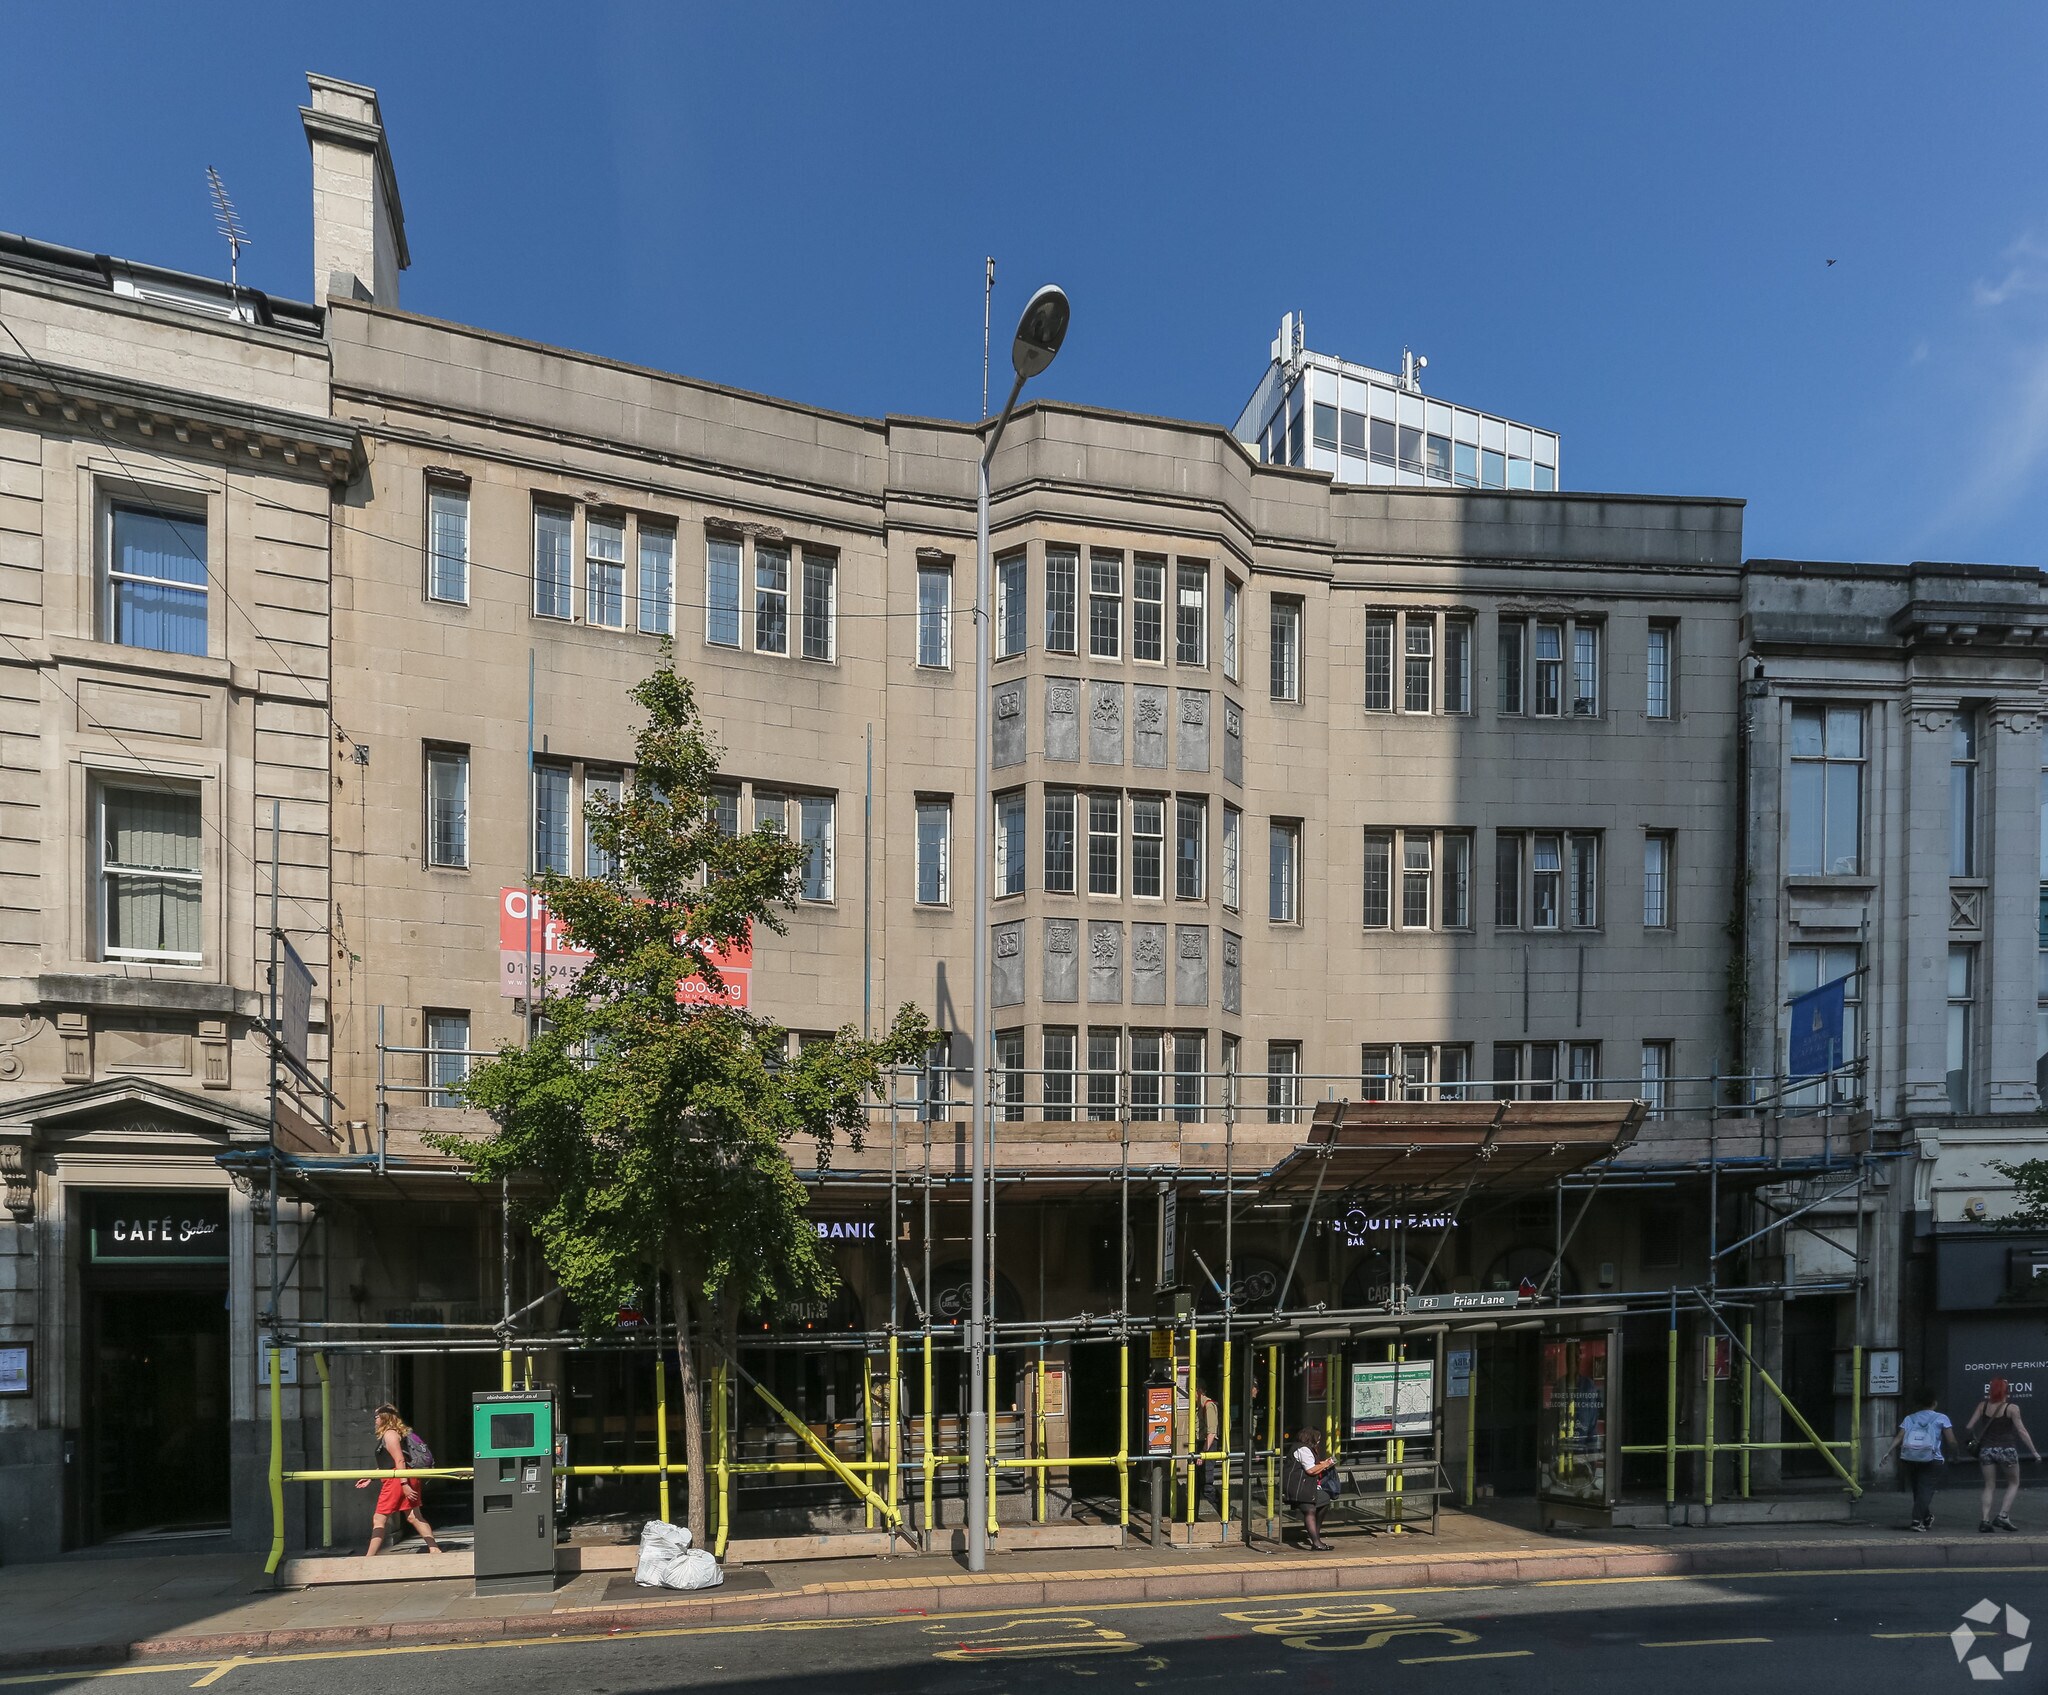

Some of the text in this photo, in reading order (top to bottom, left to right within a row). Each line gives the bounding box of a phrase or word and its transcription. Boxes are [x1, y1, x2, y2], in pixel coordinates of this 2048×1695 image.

[507, 962, 541, 976] 015
[114, 1216, 218, 1242] CAFÉ Sobar
[817, 1222, 876, 1238] BANK
[1347, 1237, 1365, 1246] BAR
[1424, 1295, 1505, 1307] F3 Friar Lane
[1984, 1382, 2033, 1394] BTON
[1222, 1602, 1482, 1651] BUS
